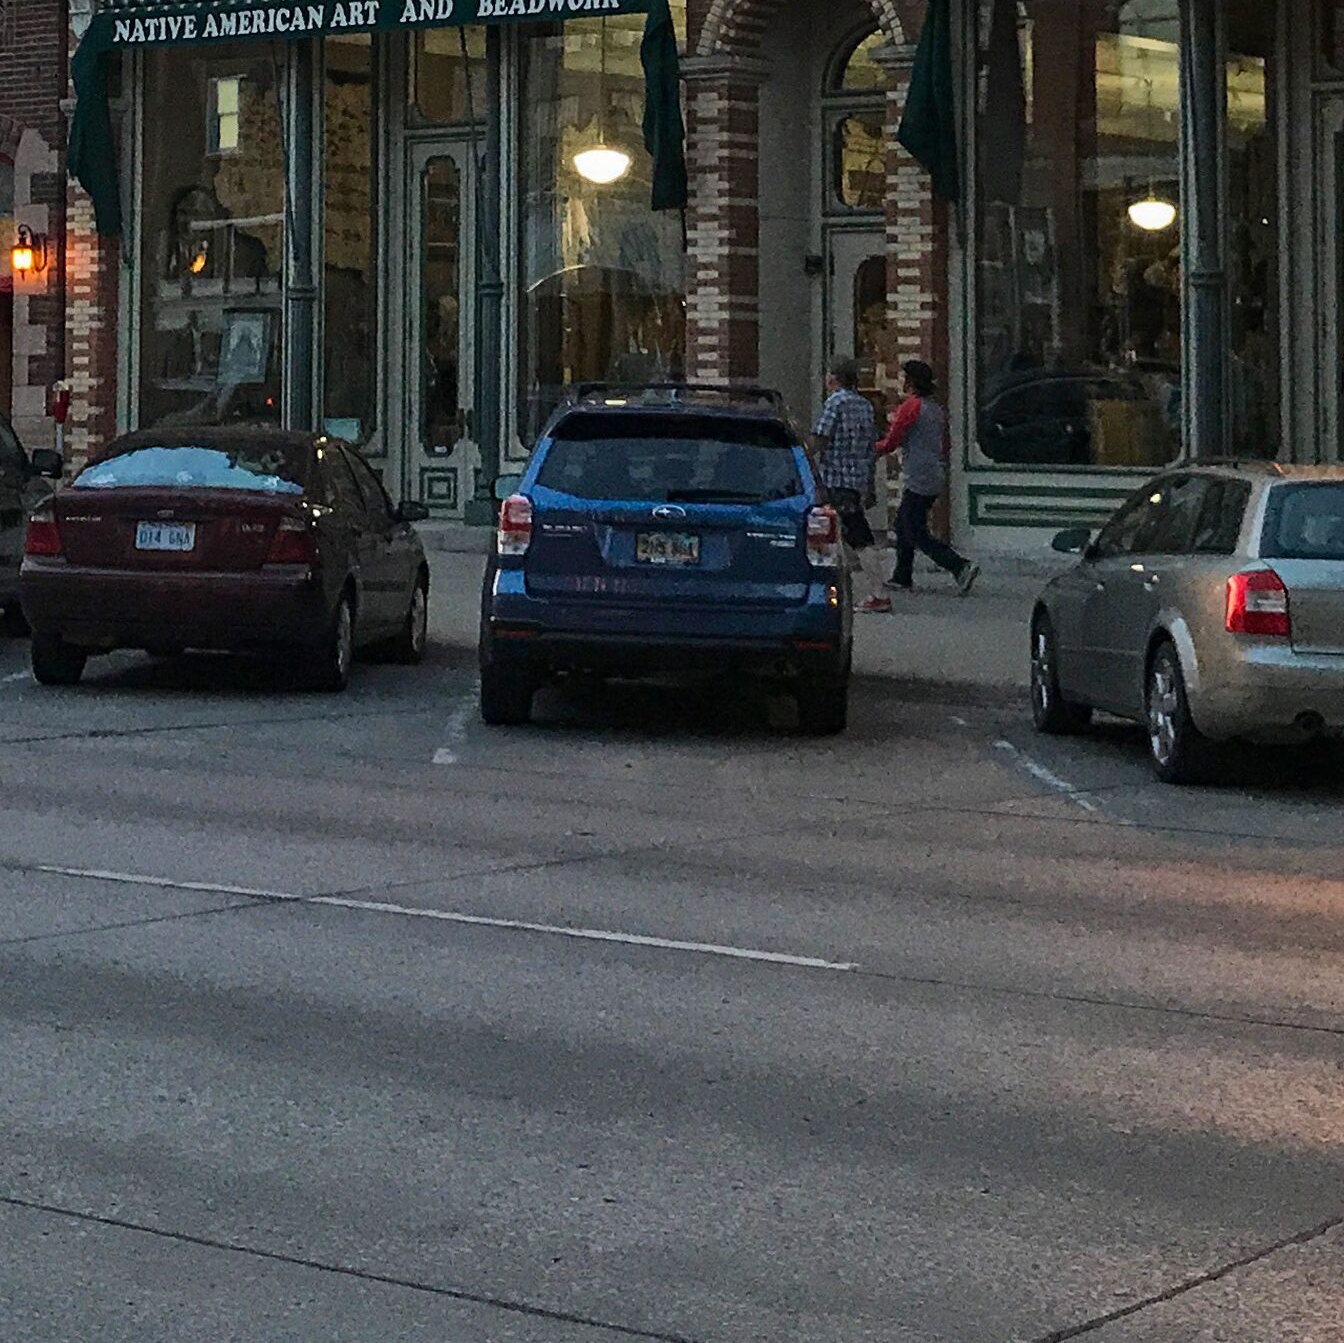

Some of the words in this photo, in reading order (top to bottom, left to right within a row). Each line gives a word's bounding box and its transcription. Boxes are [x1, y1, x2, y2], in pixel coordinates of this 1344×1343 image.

[112, 16, 197, 44] NATIVE
[203, 4, 324, 40] AMERICAN
[329, 0, 381, 28] ART
